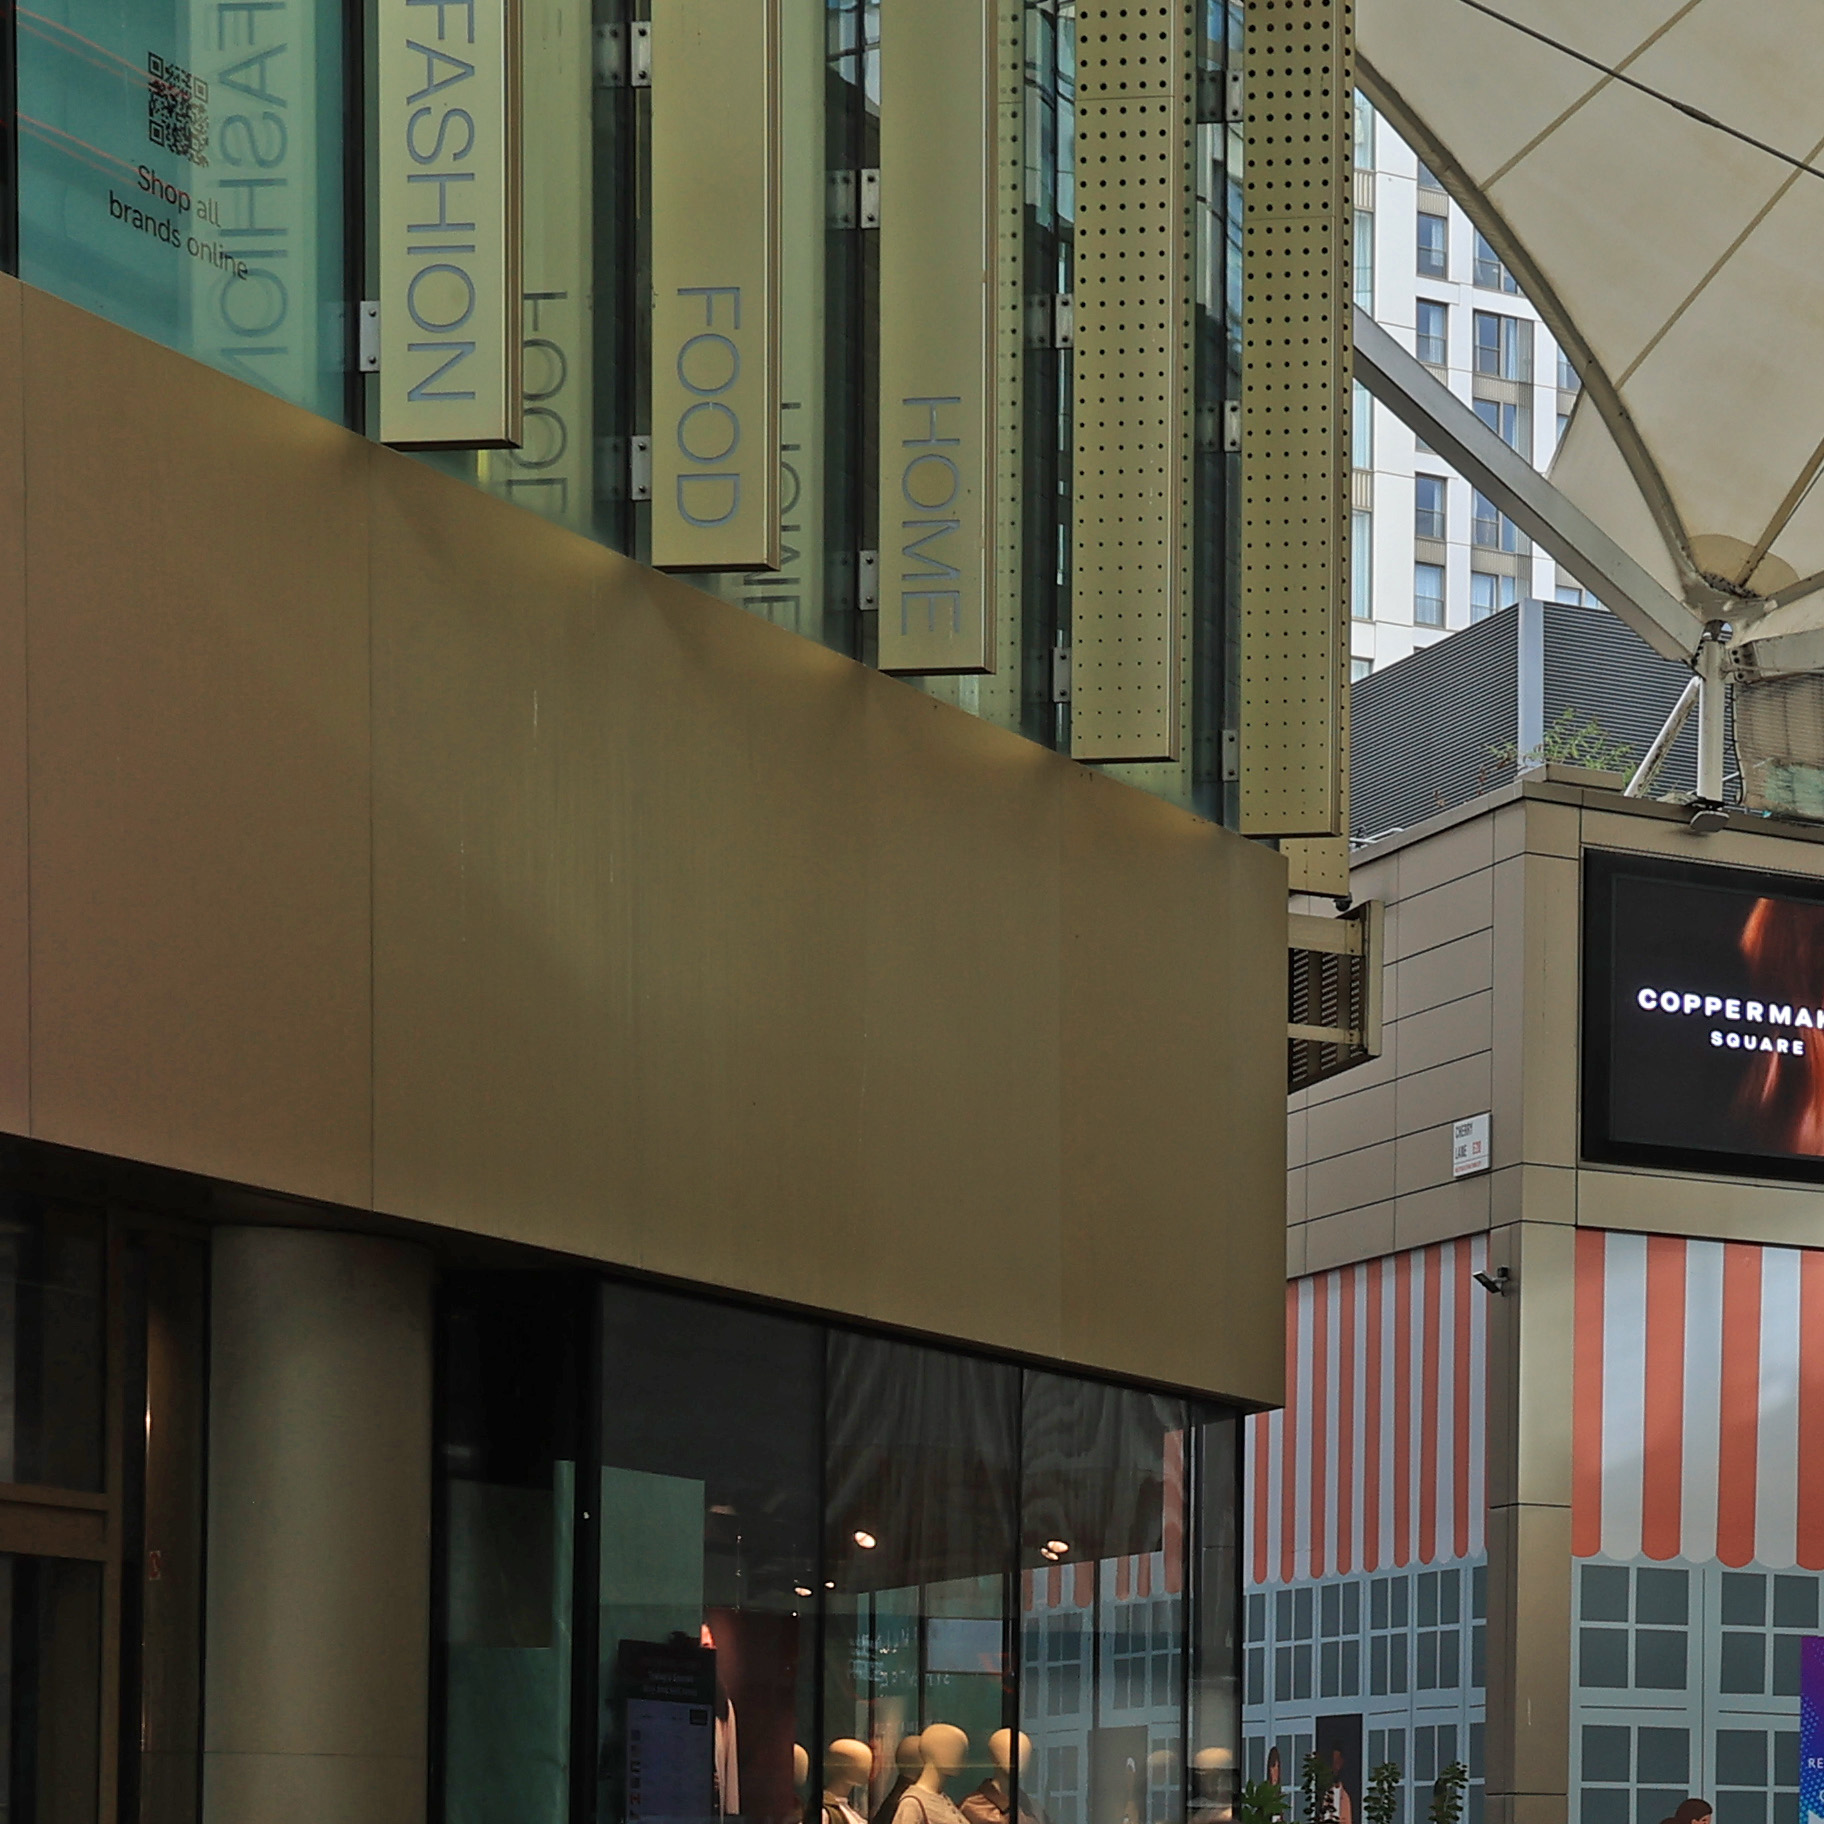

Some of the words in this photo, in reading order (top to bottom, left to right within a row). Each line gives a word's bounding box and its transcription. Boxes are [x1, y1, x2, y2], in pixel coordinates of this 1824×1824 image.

[109, 189, 182, 248] brands
[187, 236, 248, 281] online
[137, 164, 191, 214] Shop
[196, 198, 221, 228] all
[406, 0, 475, 402] FASHION
[676, 286, 741, 529] FOOD
[902, 396, 961, 636] HOME
[1710, 1030, 1805, 1056] SQUARE
